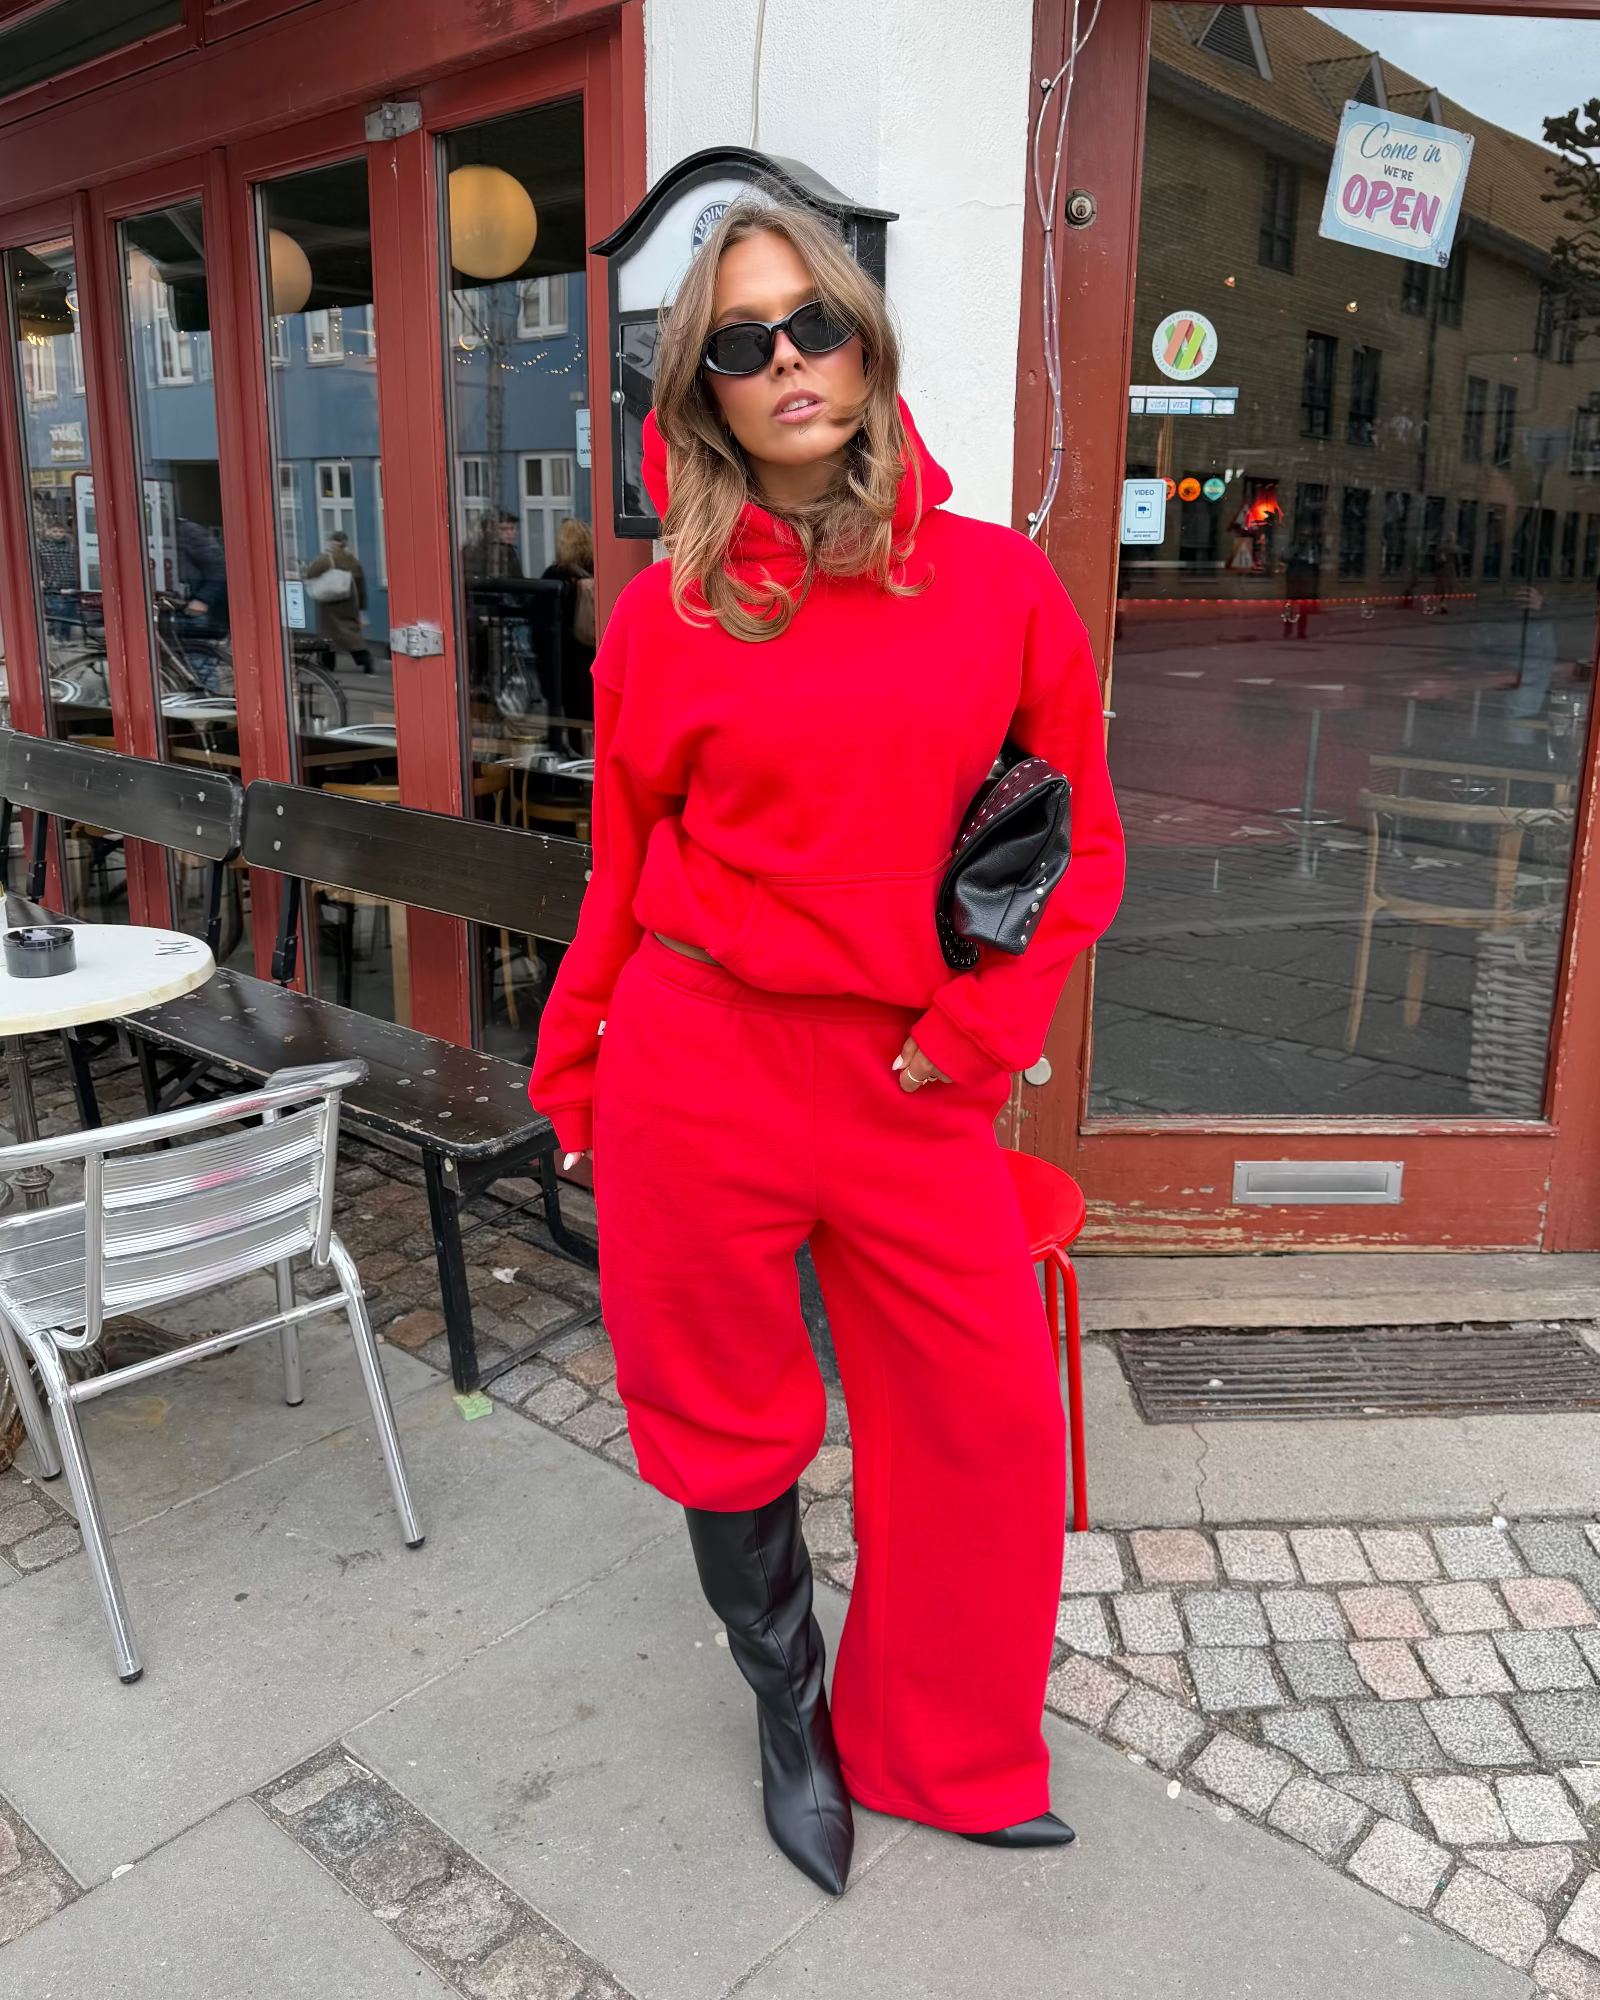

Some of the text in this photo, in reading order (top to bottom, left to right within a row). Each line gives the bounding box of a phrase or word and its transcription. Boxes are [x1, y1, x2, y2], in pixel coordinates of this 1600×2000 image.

[1360, 121, 1442, 163] Come in
[1383, 164, 1414, 182] WE'RE
[1342, 173, 1442, 236] OPEN
[1172, 401, 1189, 409] VISA
